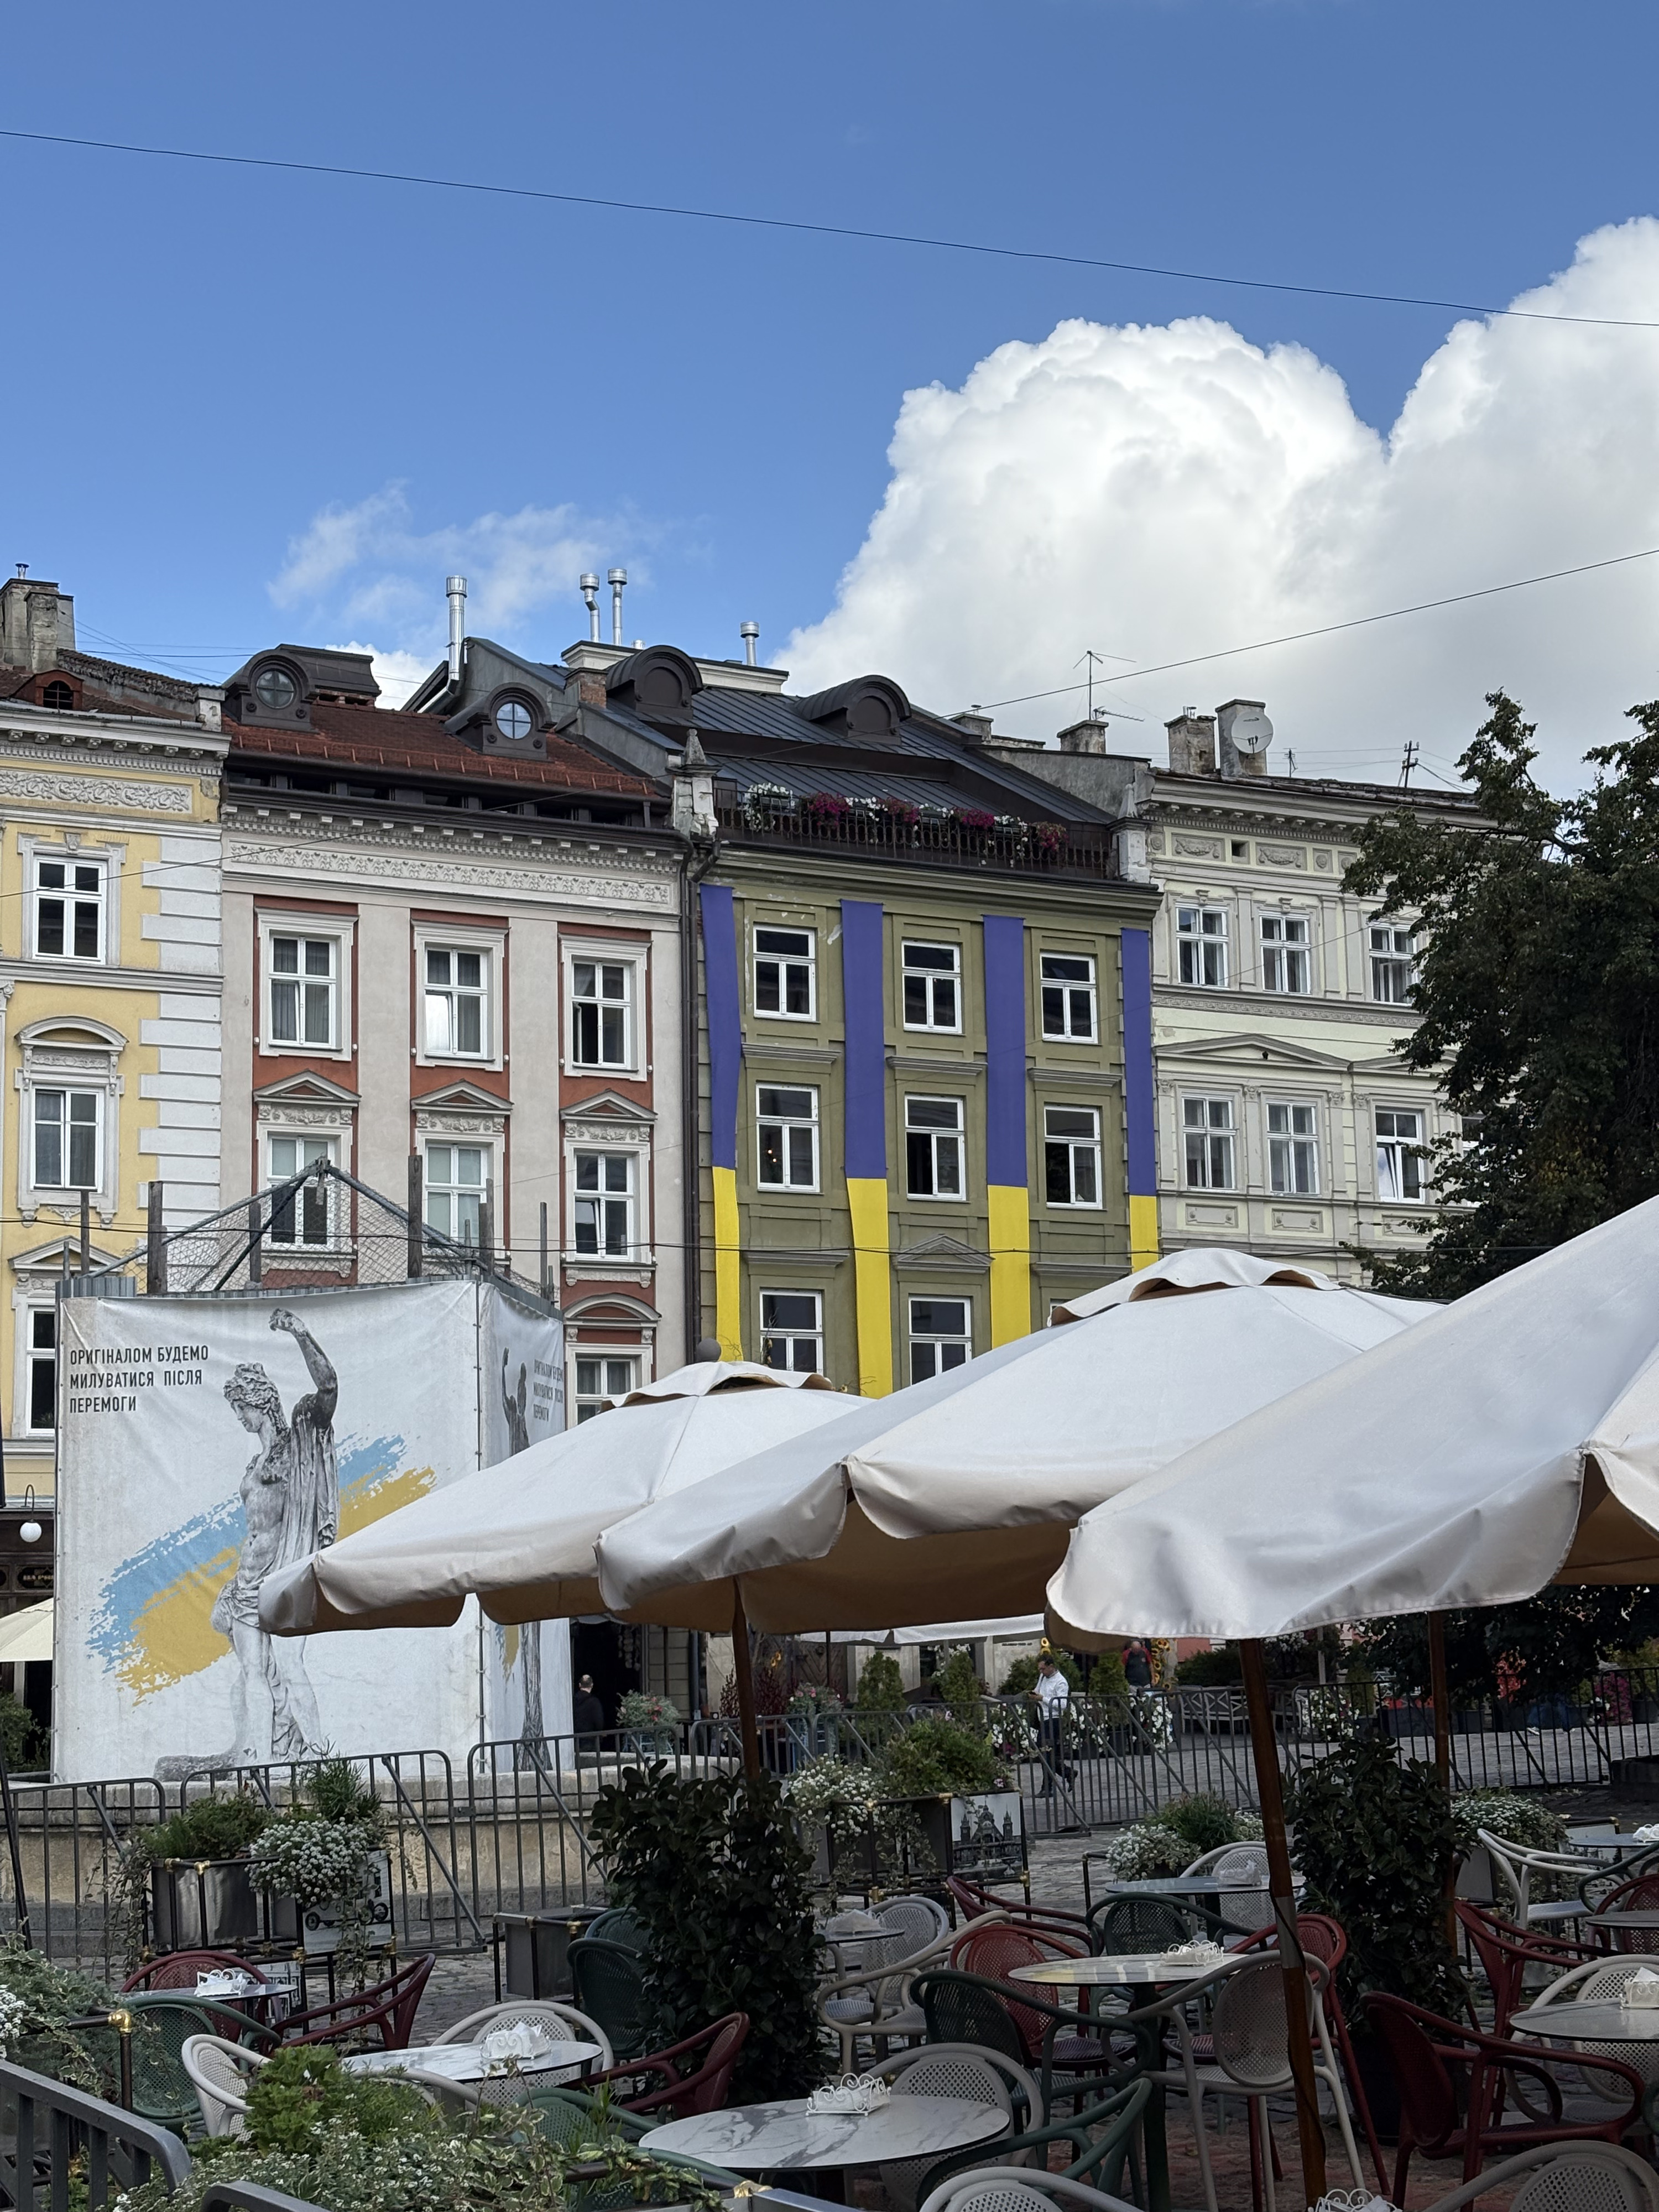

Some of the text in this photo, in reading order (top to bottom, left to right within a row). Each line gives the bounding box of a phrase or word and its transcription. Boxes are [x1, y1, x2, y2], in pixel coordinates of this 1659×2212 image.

[70, 1345, 208, 1365] ОРИГІНАЛОМ БУДЕМО
[70, 1370, 202, 1389] МИЛУВАТИСЯ ПІСЛЯ
[70, 1396, 136, 1413] ПЕРЕМОГИ
